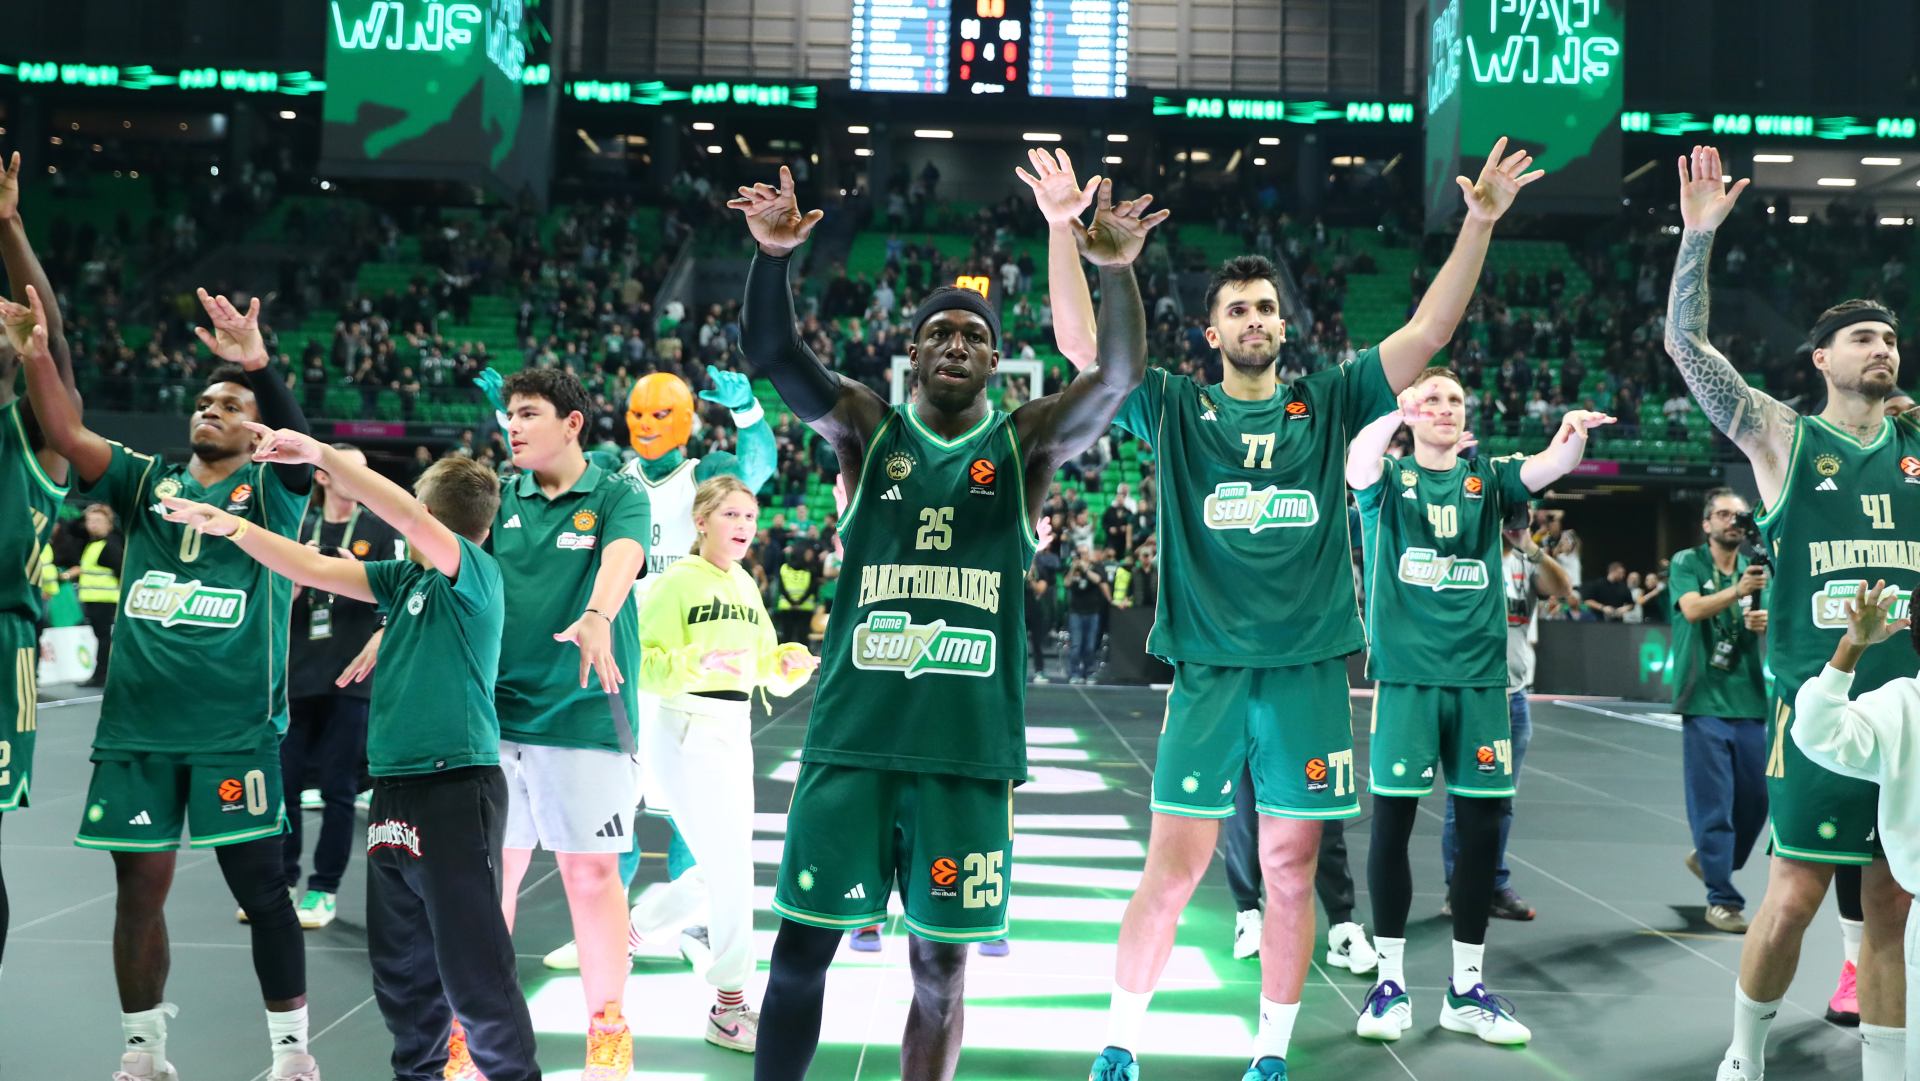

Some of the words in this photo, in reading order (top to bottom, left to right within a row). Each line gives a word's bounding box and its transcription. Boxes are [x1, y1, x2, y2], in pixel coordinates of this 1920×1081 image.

[331, 1, 482, 50] WINS
[1466, 35, 1620, 84] WINS
[1186, 98, 1224, 117] PAO
[1346, 102, 1384, 122] PAO
[1241, 432, 1275, 469] 77
[915, 506, 955, 551] 25
[1426, 503, 1458, 538] 40
[1860, 493, 1896, 530] 41
[857, 563, 1001, 614] PANATHINAIKOS
[872, 617, 903, 630] pame
[244, 769, 269, 816] 0
[1327, 748, 1356, 797] 77
[962, 850, 1004, 909] 25
